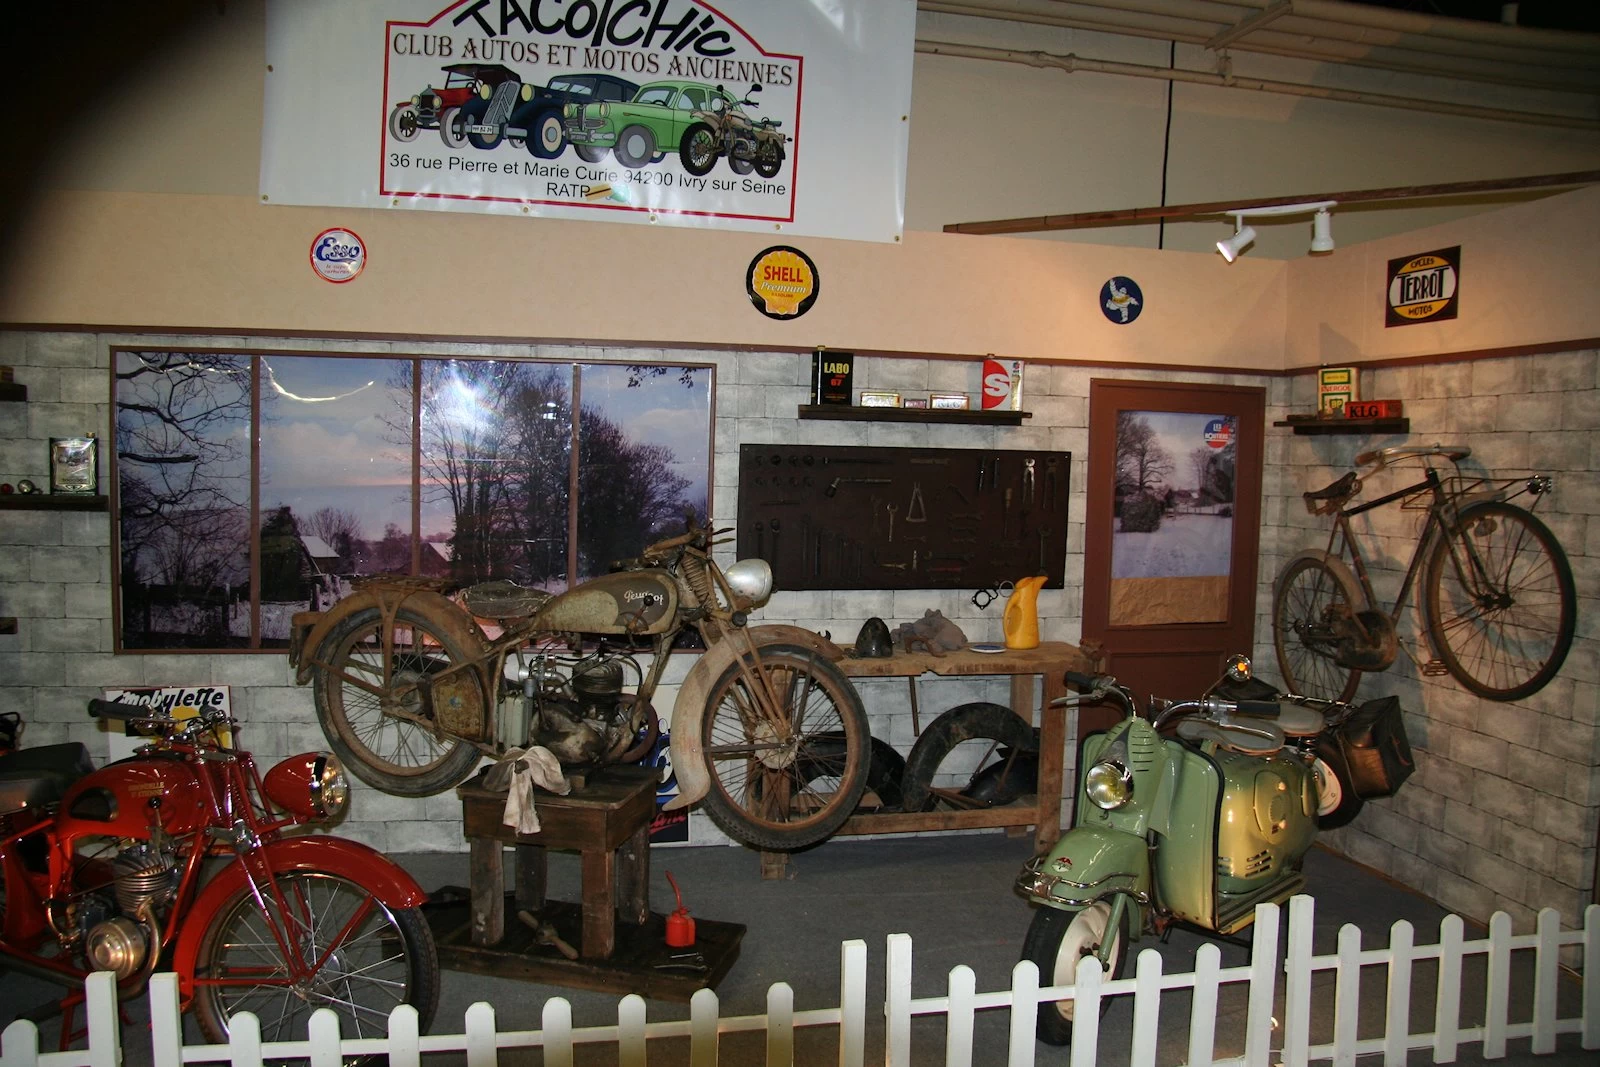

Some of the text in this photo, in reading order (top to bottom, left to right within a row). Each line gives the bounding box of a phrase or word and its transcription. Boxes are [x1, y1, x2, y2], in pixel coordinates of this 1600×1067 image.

[393, 32, 793, 86] CLUB AUTOS ET MOTOS ANCIENNES
[389, 153, 786, 195] 36 rue Pierre et Marie Curie 94200 Ivry sur Seine
[546, 182, 591, 198] RATP
[316, 237, 360, 262] Esso
[1410, 257, 1435, 268] CYCLES
[764, 265, 803, 283] SHELL
[761, 281, 806, 293] Premium
[1397, 267, 1450, 304] TERROT
[1408, 305, 1433, 316] MOTOS
[824, 362, 850, 375] LABO
[984, 373, 1010, 397] S
[1331, 400, 1342, 409] BP
[1350, 406, 1379, 418] KLG
